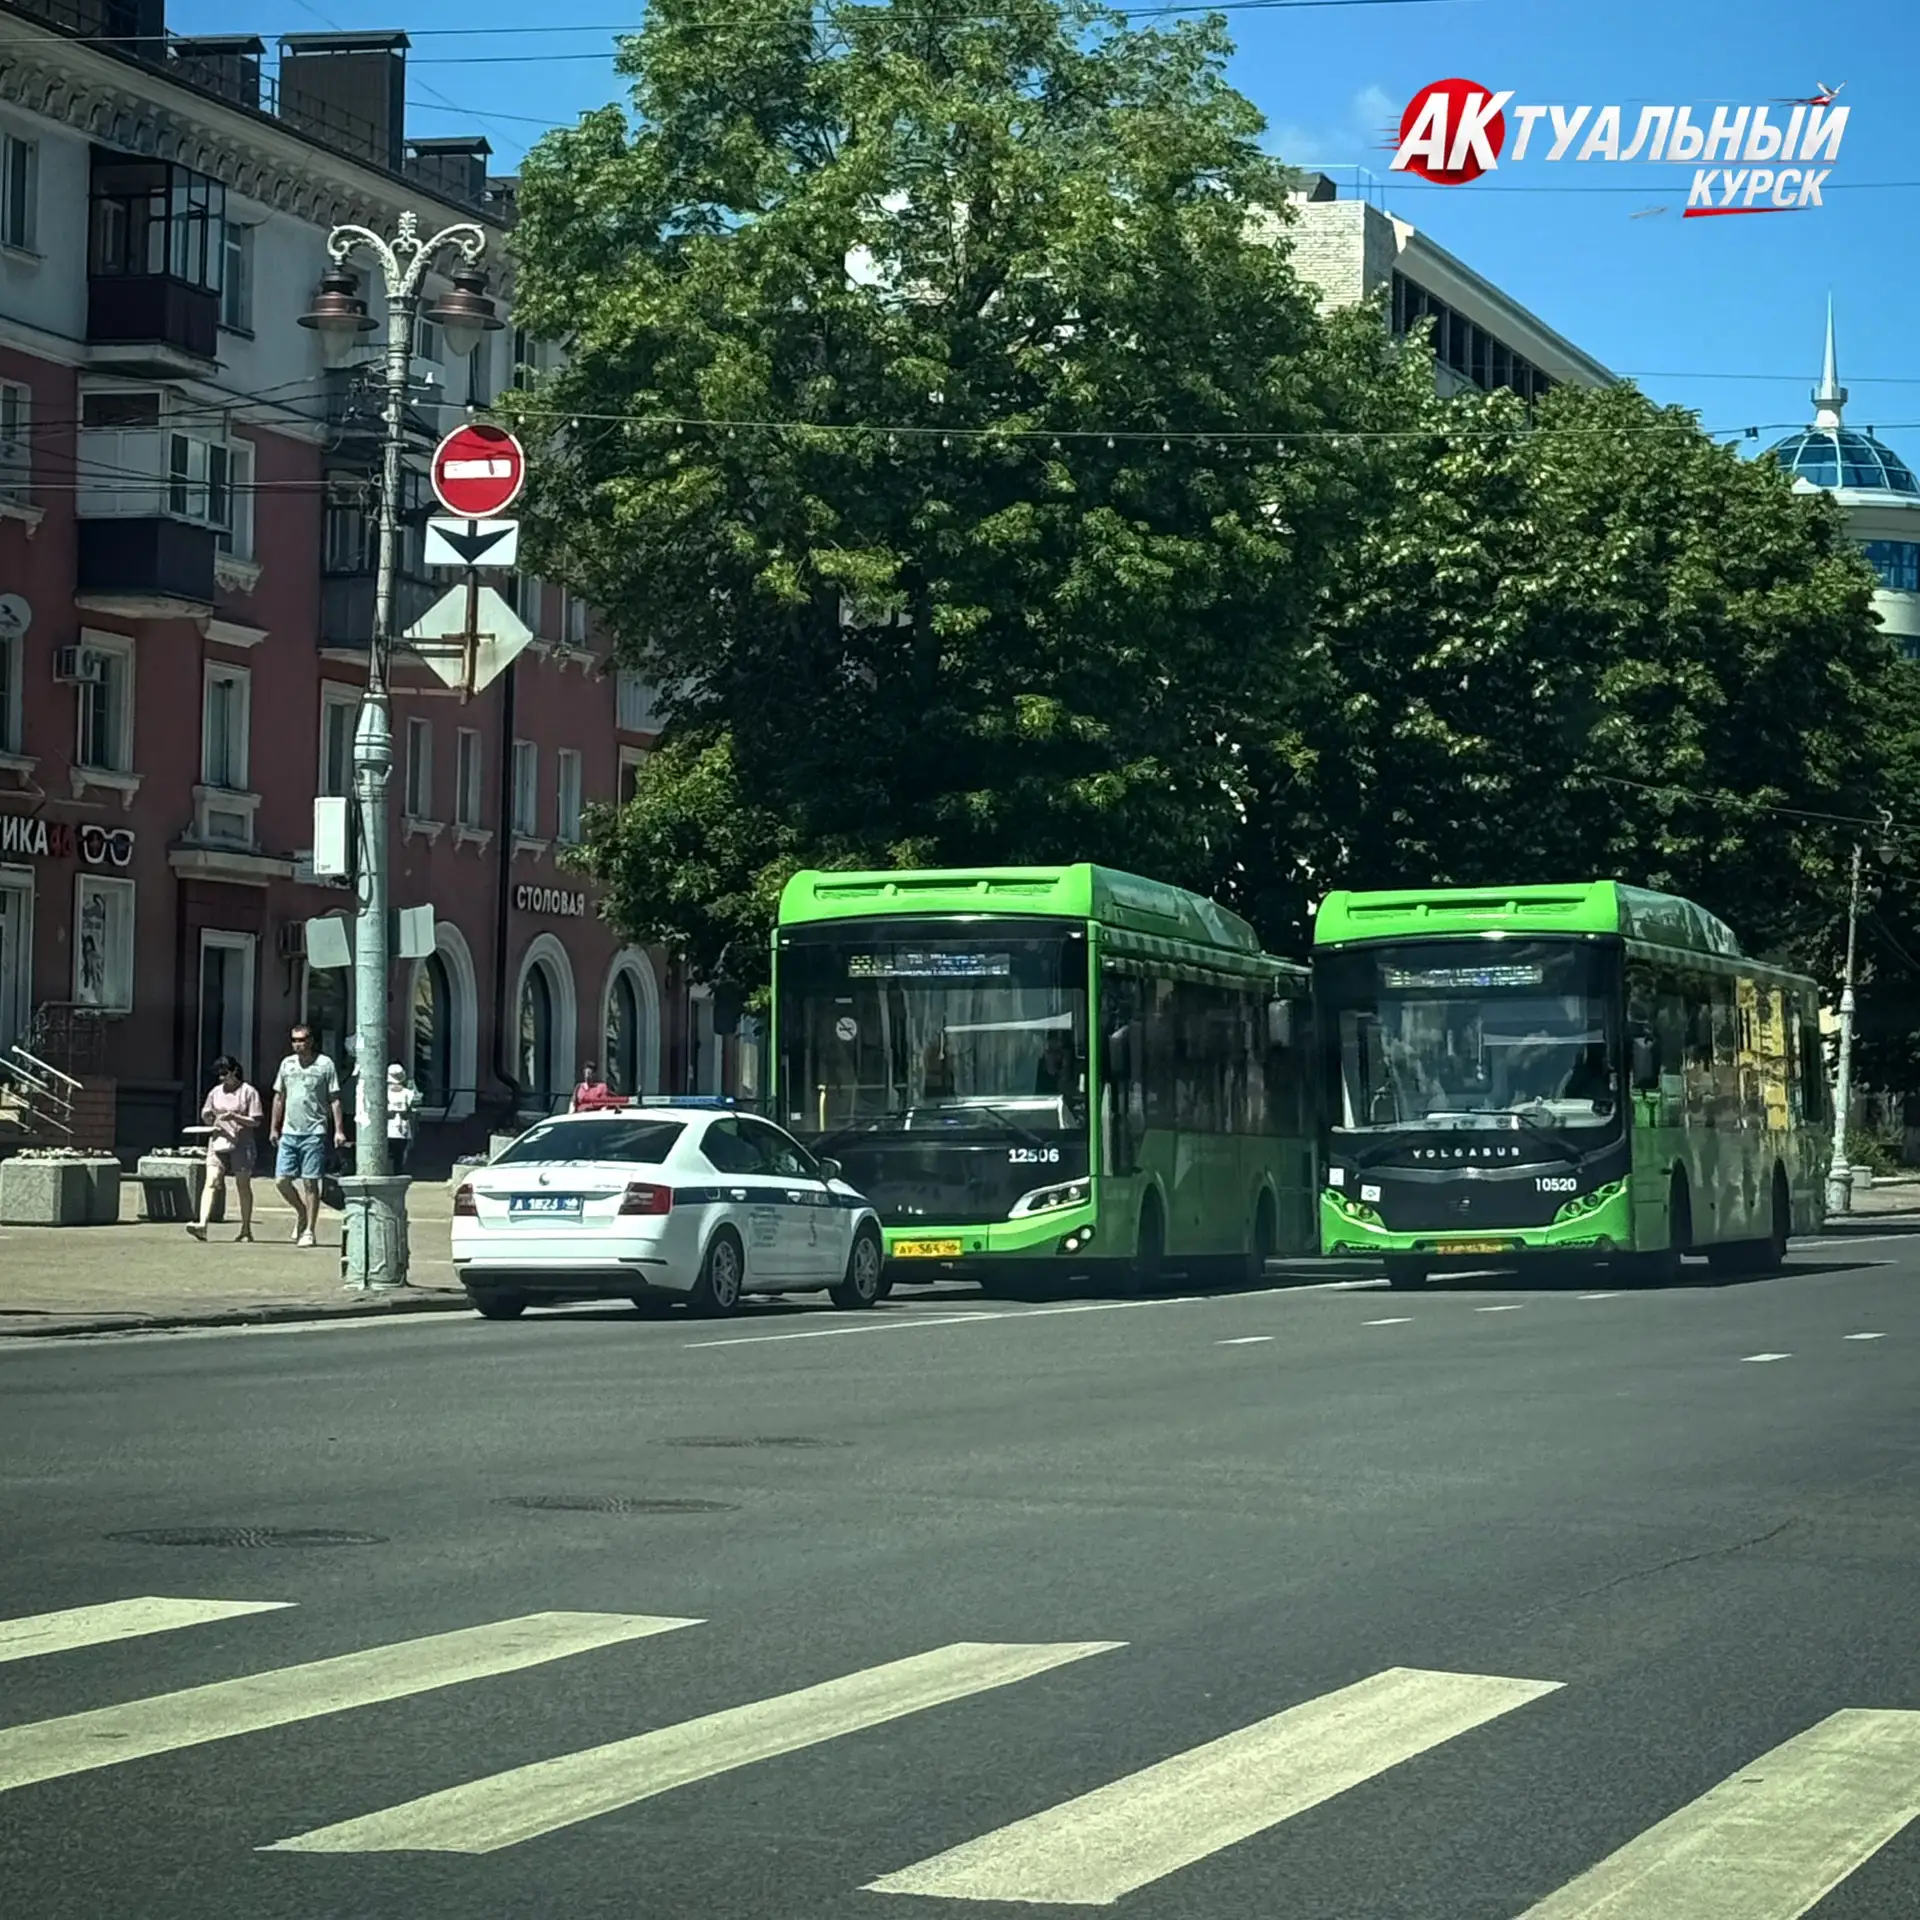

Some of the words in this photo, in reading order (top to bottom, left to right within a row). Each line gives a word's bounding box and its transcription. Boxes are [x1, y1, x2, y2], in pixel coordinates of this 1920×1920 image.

[0, 815, 49, 856] ИКА
[517, 885, 585, 916] СТОЛОВАЯ
[1008, 1148, 1060, 1162] 12506
[1412, 1146, 1520, 1159] VOLGABUS
[1535, 1178, 1577, 1191] 10520
